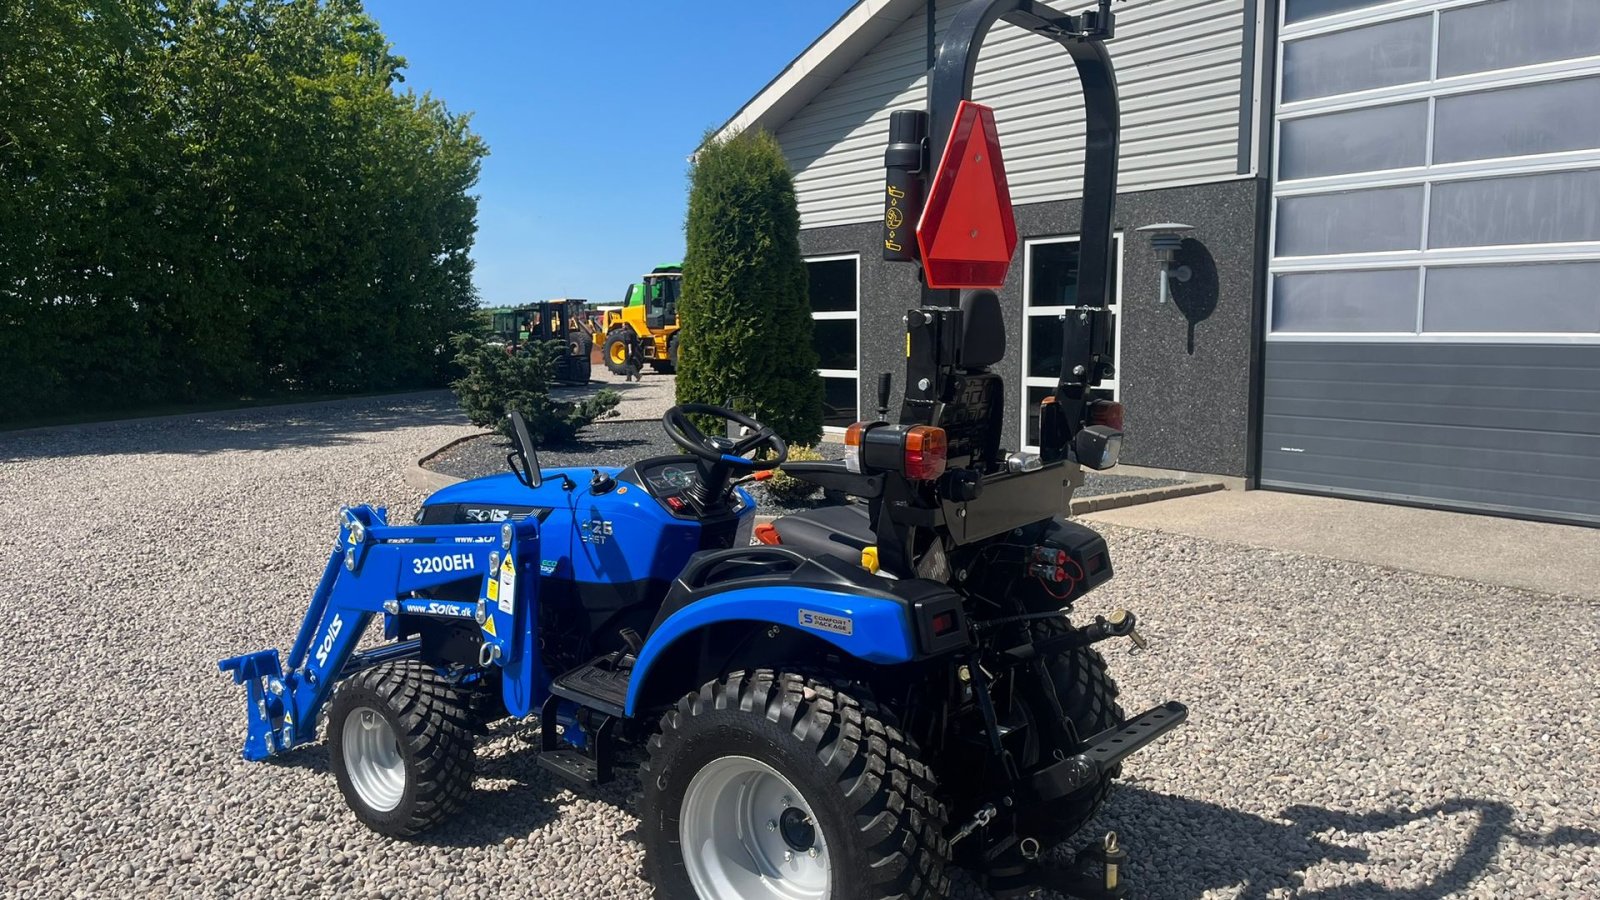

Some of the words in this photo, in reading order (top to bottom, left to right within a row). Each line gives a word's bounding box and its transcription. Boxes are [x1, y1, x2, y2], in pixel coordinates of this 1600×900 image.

[412, 553, 474, 574] 3200EH
[814, 615, 846, 626] COMFORT
[814, 620, 846, 631] PACKAGE
